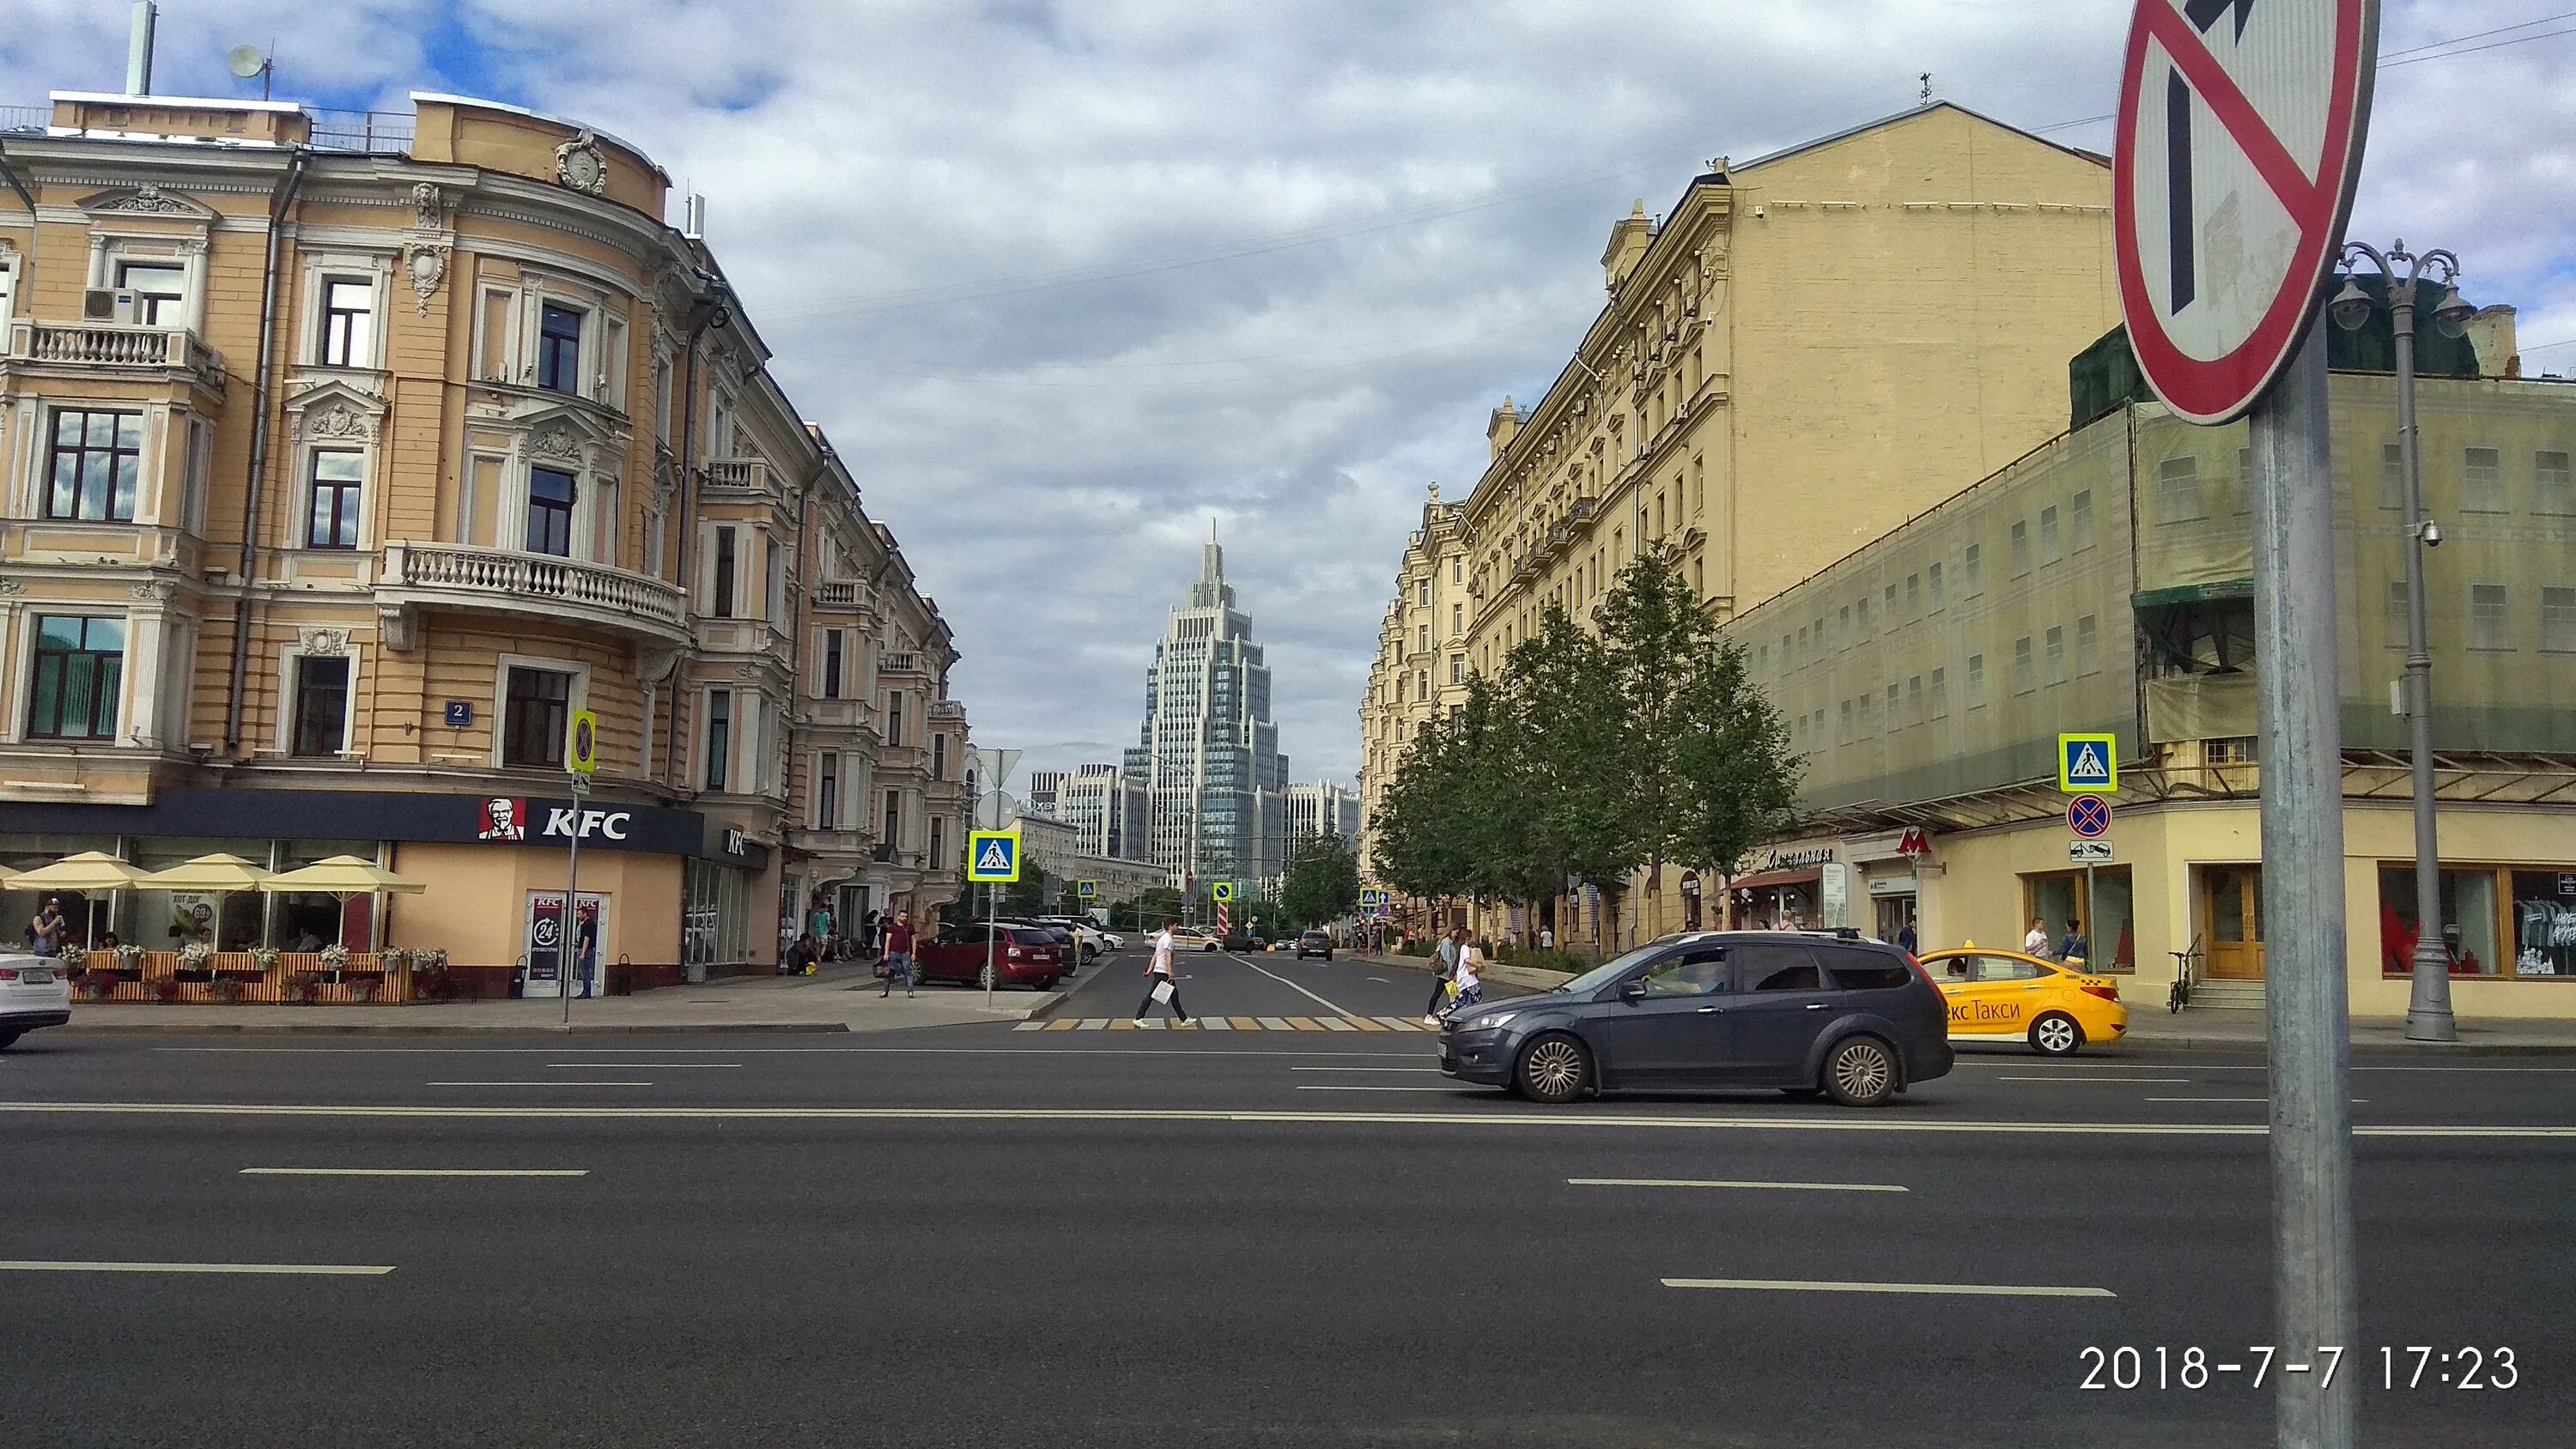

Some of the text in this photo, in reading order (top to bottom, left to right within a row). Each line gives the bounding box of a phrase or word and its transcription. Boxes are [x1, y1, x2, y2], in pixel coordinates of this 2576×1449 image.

[453, 705, 463, 717] 2
[542, 808, 631, 840] KFC
[728, 829, 744, 856] KFC
[173, 894, 202, 905] ХОТ-ДОГ
[579, 899, 597, 907] KFC
[538, 925, 554, 938] 24
[1971, 999, 2020, 1020] Такси
